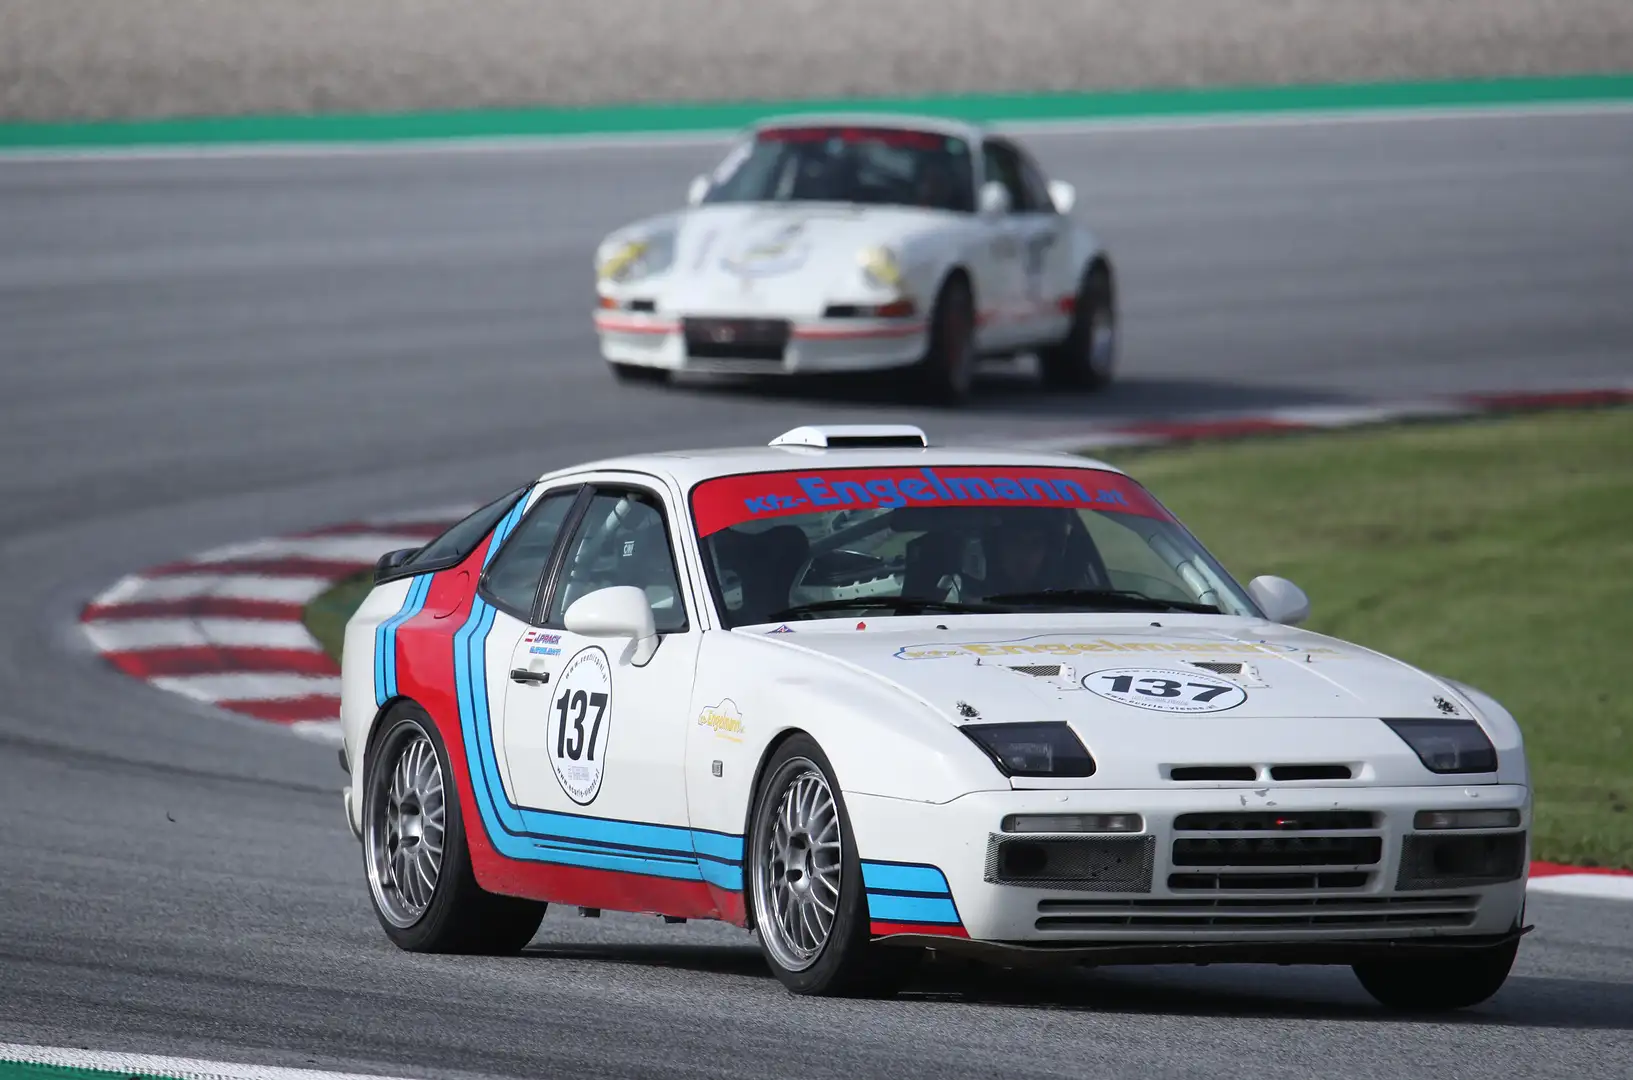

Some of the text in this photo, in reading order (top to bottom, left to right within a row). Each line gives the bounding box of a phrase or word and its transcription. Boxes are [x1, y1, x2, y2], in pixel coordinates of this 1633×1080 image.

[744, 468, 1128, 513] Kfz-Engelmann.at
[1101, 675, 1233, 703] 137
[556, 688, 608, 761] 137
